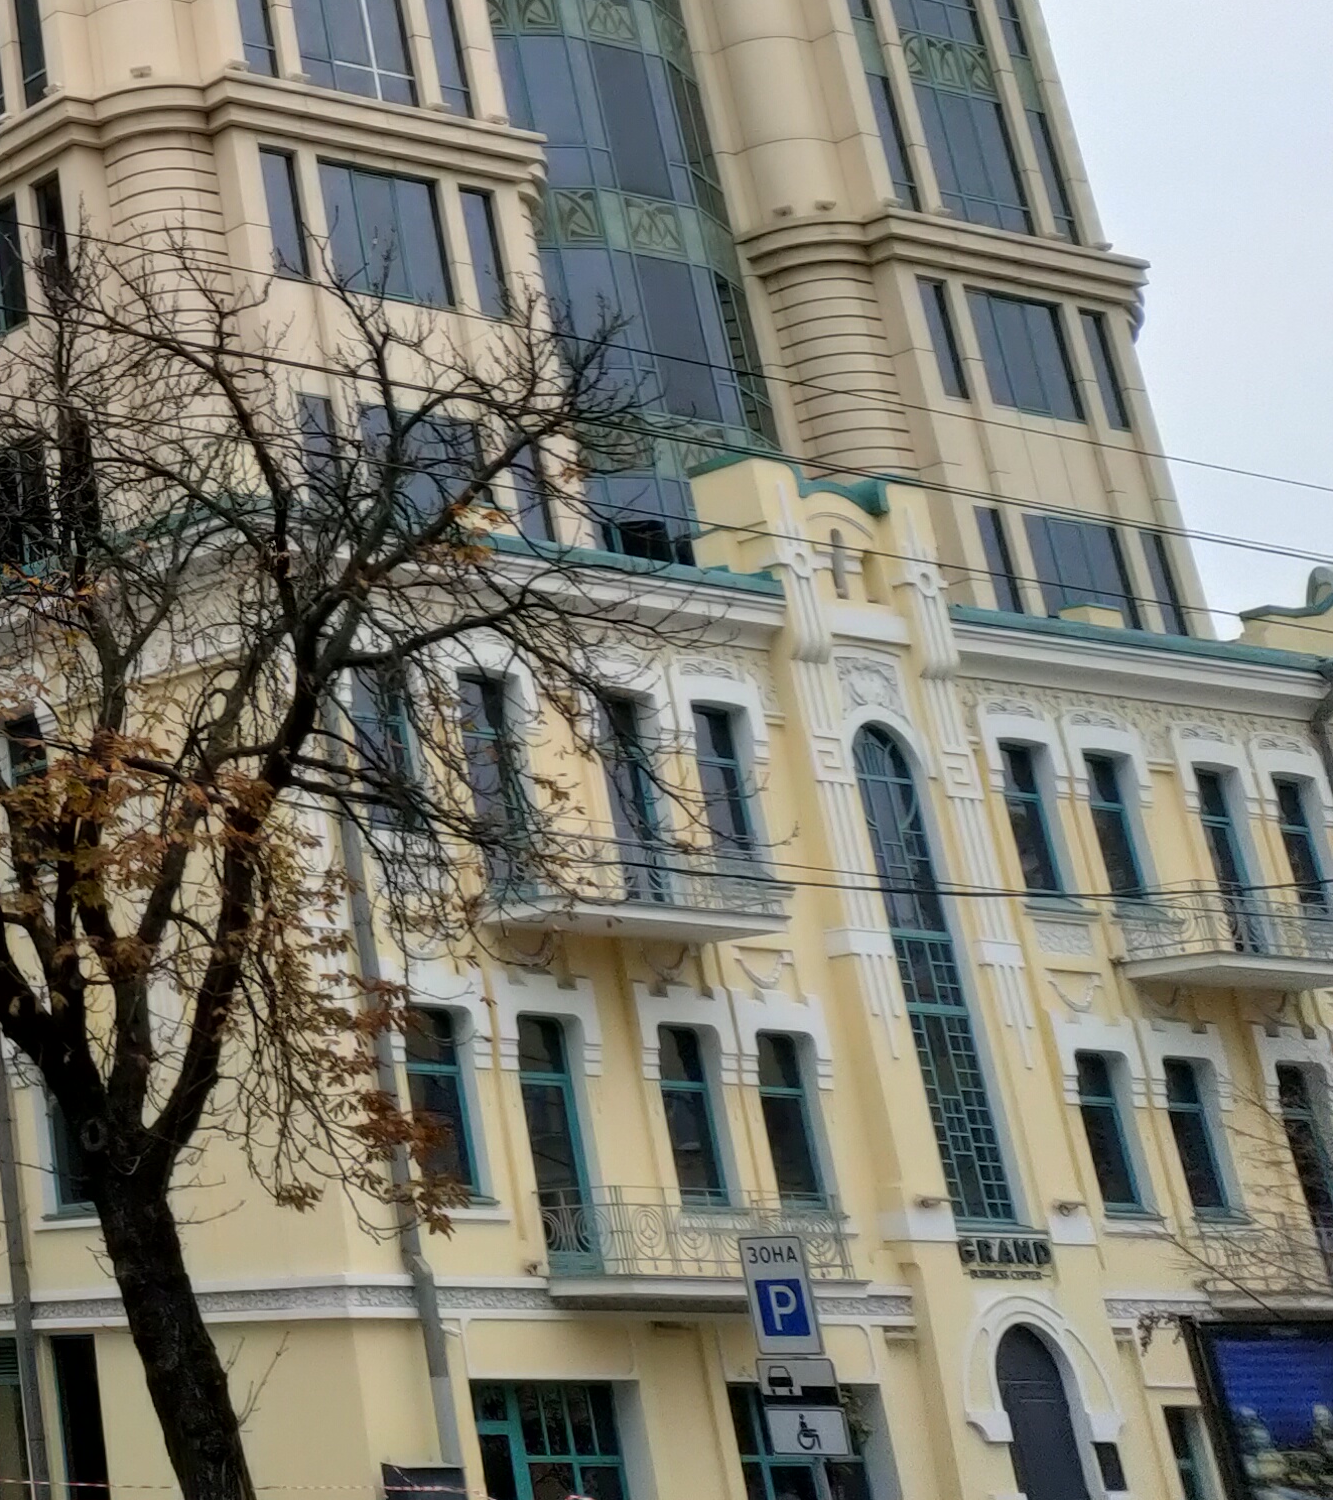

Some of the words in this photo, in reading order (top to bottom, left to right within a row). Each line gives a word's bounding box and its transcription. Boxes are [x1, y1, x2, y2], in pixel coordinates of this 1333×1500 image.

[746, 1245, 799, 1264] ЗОНА
[958, 1238, 1052, 1266] GRAND
[768, 1284, 798, 1332] P
